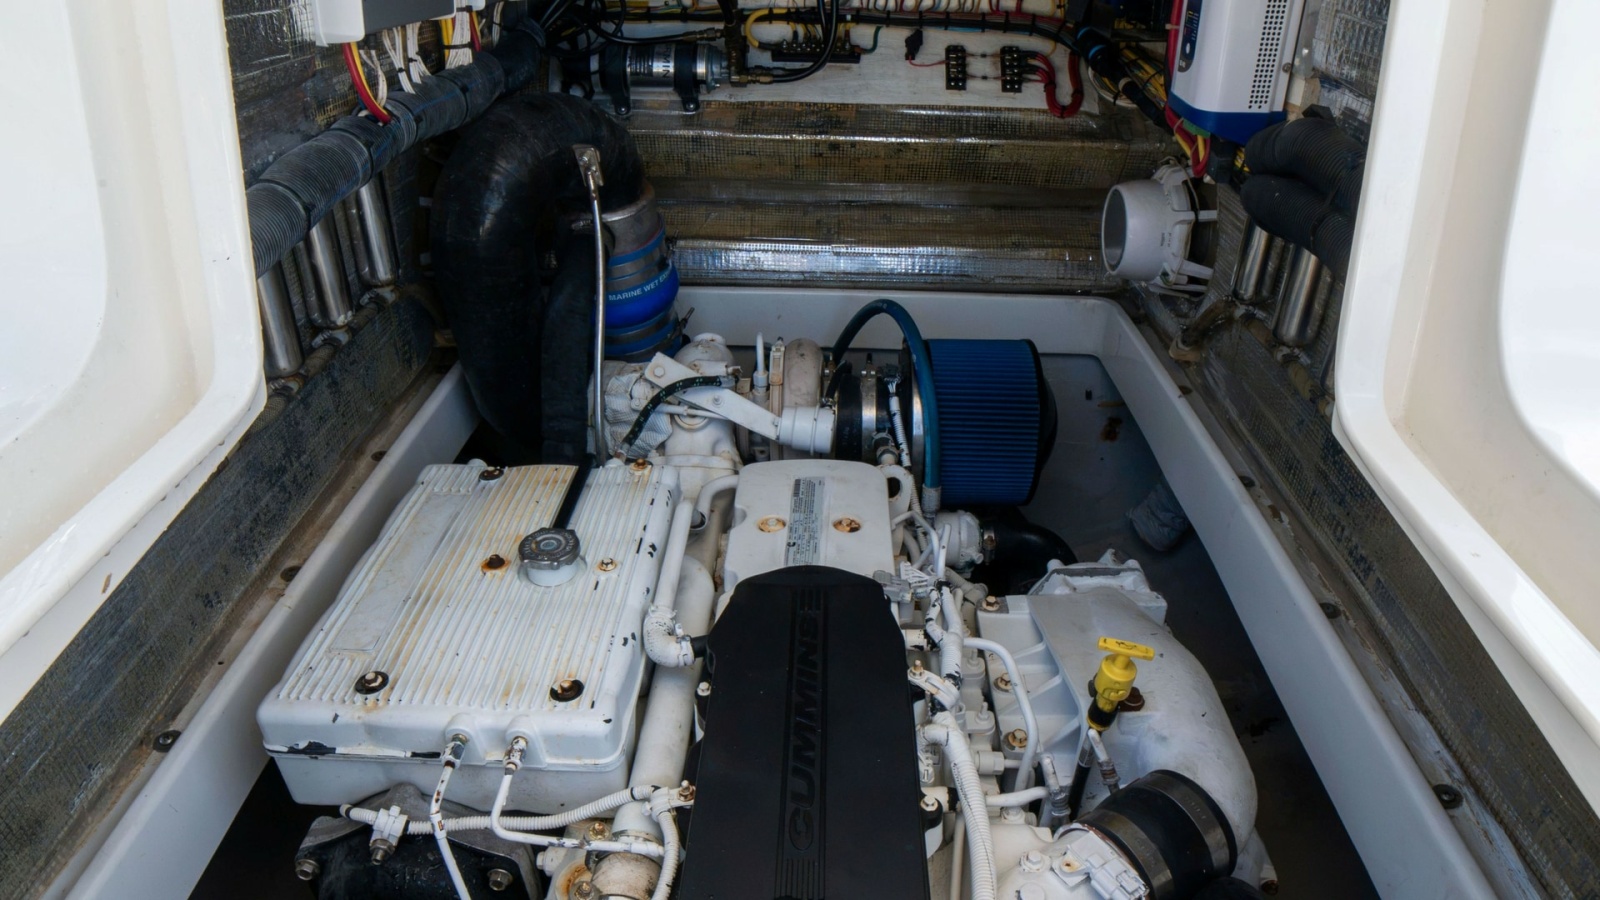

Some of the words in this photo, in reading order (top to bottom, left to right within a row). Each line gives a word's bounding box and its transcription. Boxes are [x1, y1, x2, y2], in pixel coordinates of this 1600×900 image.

[662, 47, 672, 78] RMIN
[608, 288, 642, 300] MARINE
[643, 279, 658, 292] WET
[789, 616, 819, 852] CUMMINS
